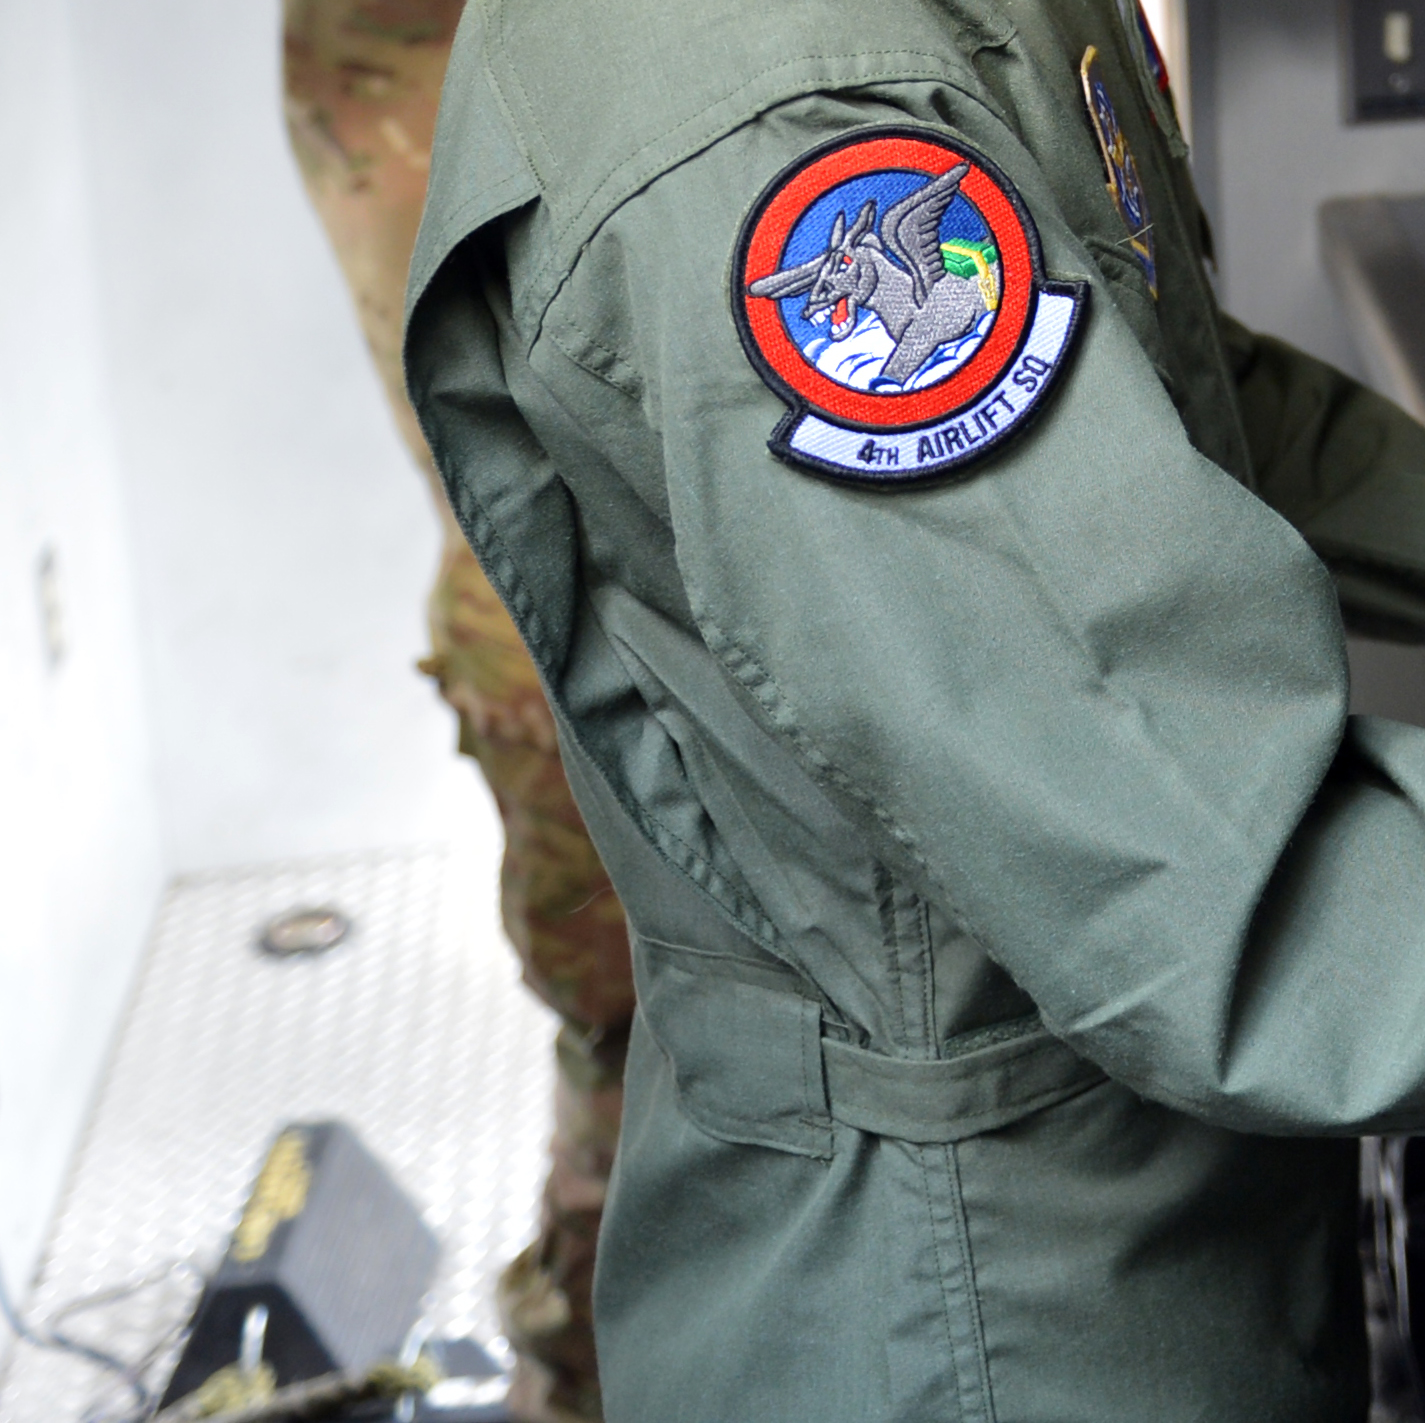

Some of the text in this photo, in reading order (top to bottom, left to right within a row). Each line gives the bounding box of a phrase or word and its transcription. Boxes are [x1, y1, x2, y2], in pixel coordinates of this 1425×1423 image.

[855, 356, 1051, 466] 4TH AIRLIFT SQ
